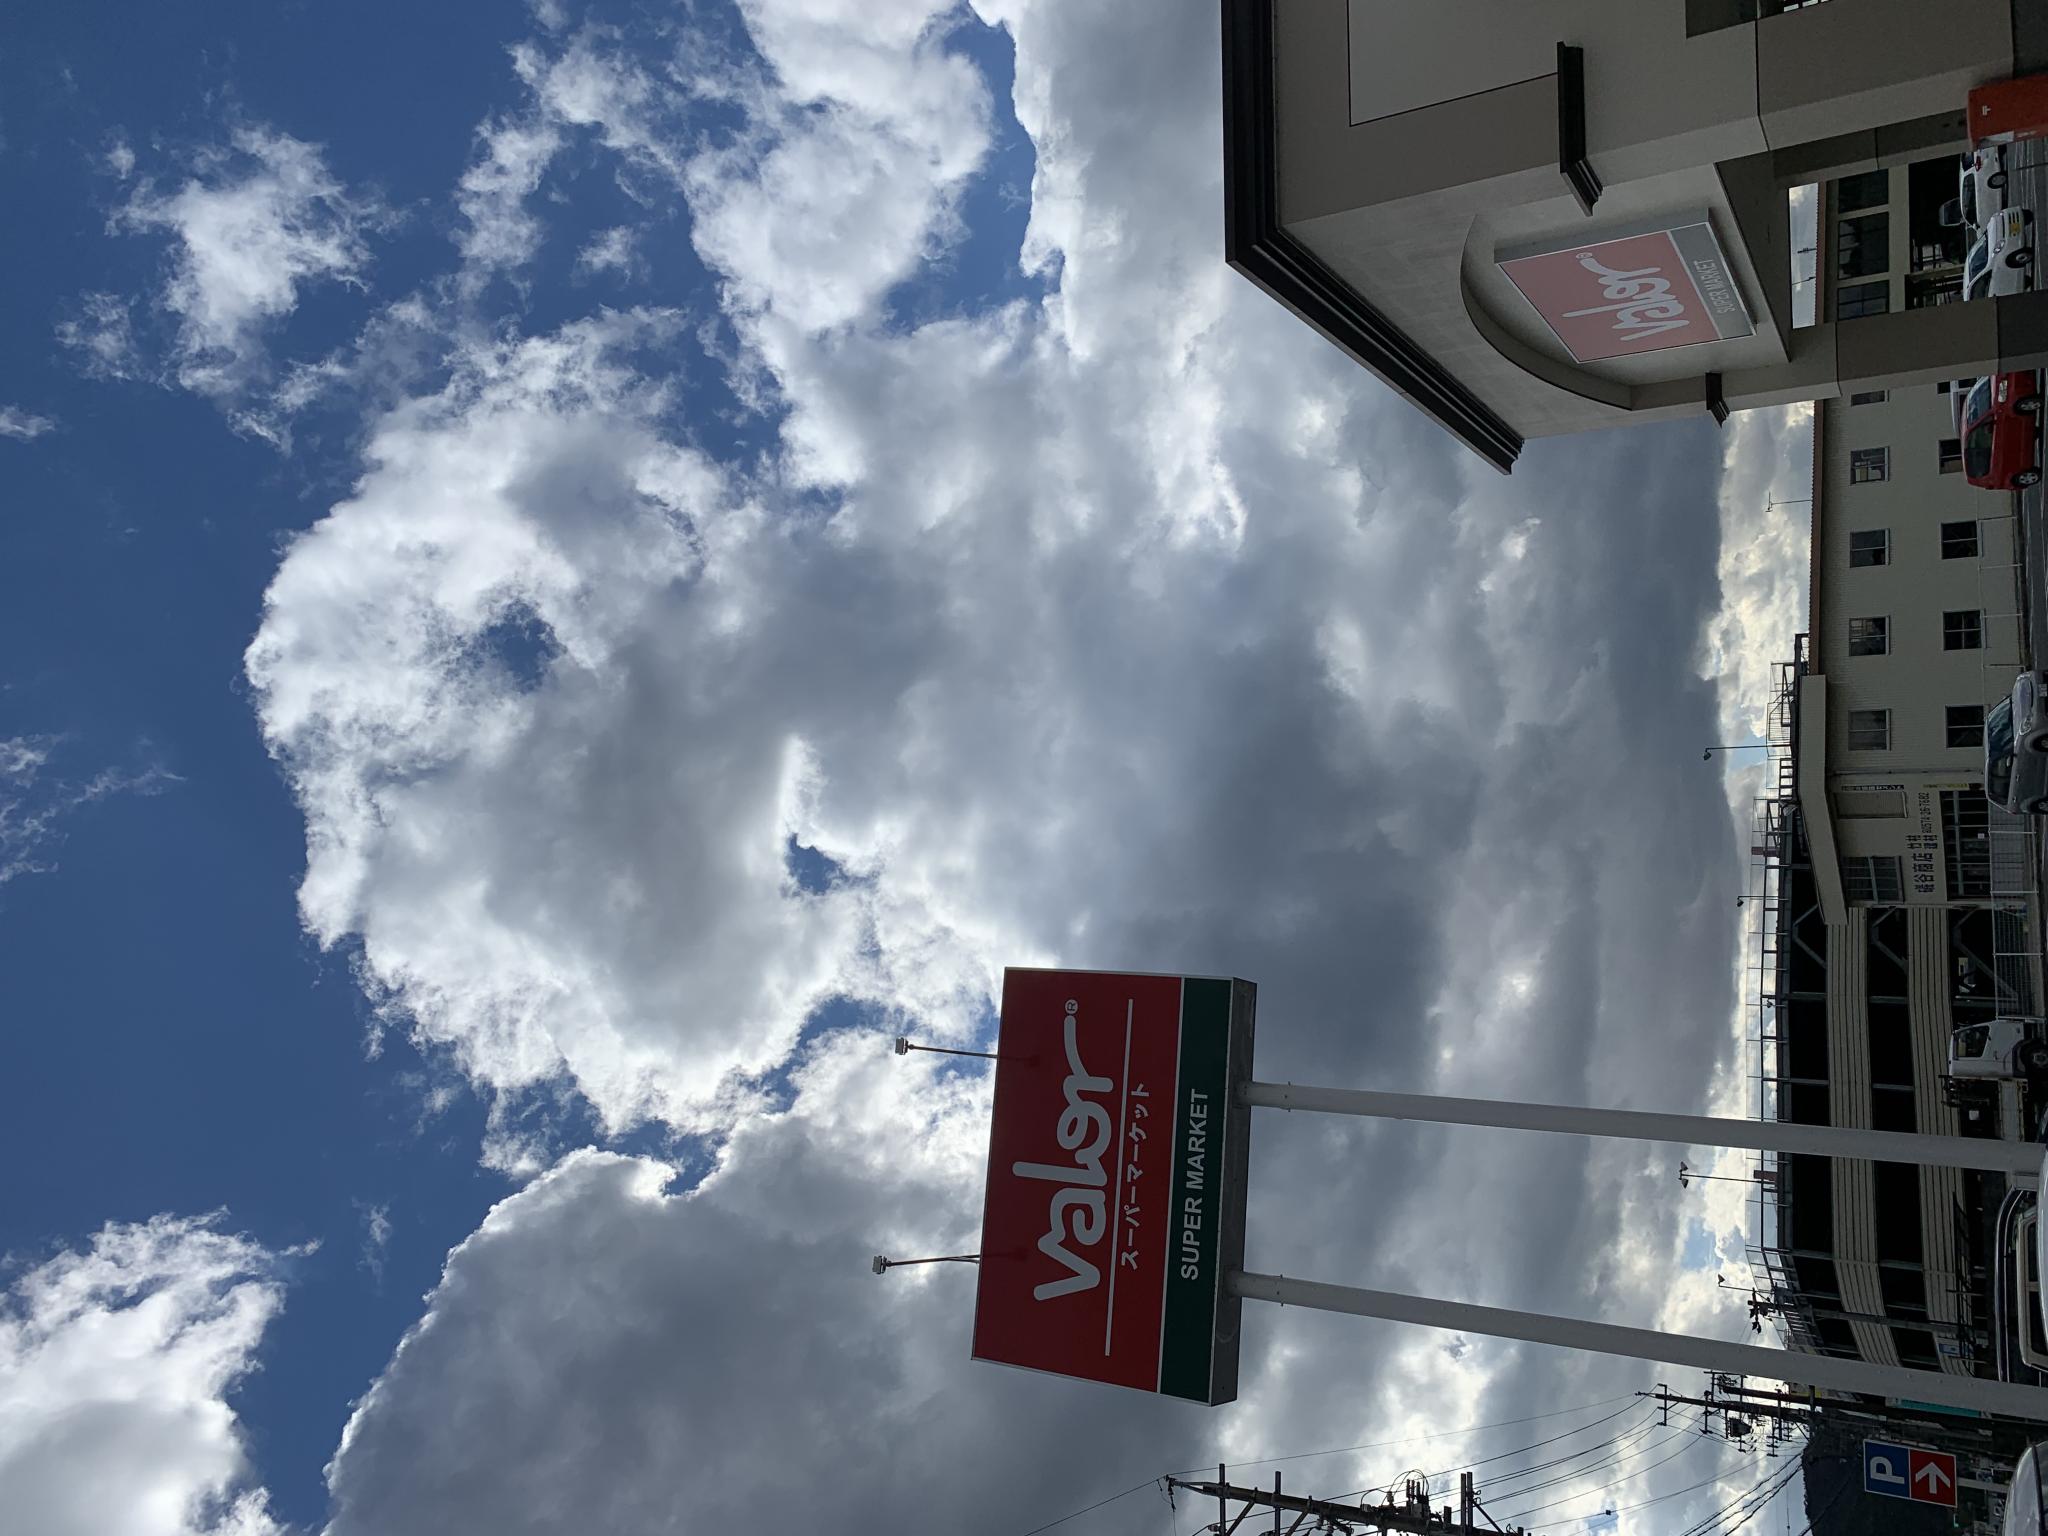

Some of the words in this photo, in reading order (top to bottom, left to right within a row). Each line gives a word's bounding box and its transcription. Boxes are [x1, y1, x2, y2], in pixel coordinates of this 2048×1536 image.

[1693, 259, 1725, 290] MARKET
[1708, 289, 1736, 313] SUPER
[1185, 1088, 1209, 1190] MARKET
[1120, 1082, 1150, 1270] スーパーマーケット
[1180, 1197, 1203, 1280] SUPER
[1869, 1456, 1905, 1485] P
